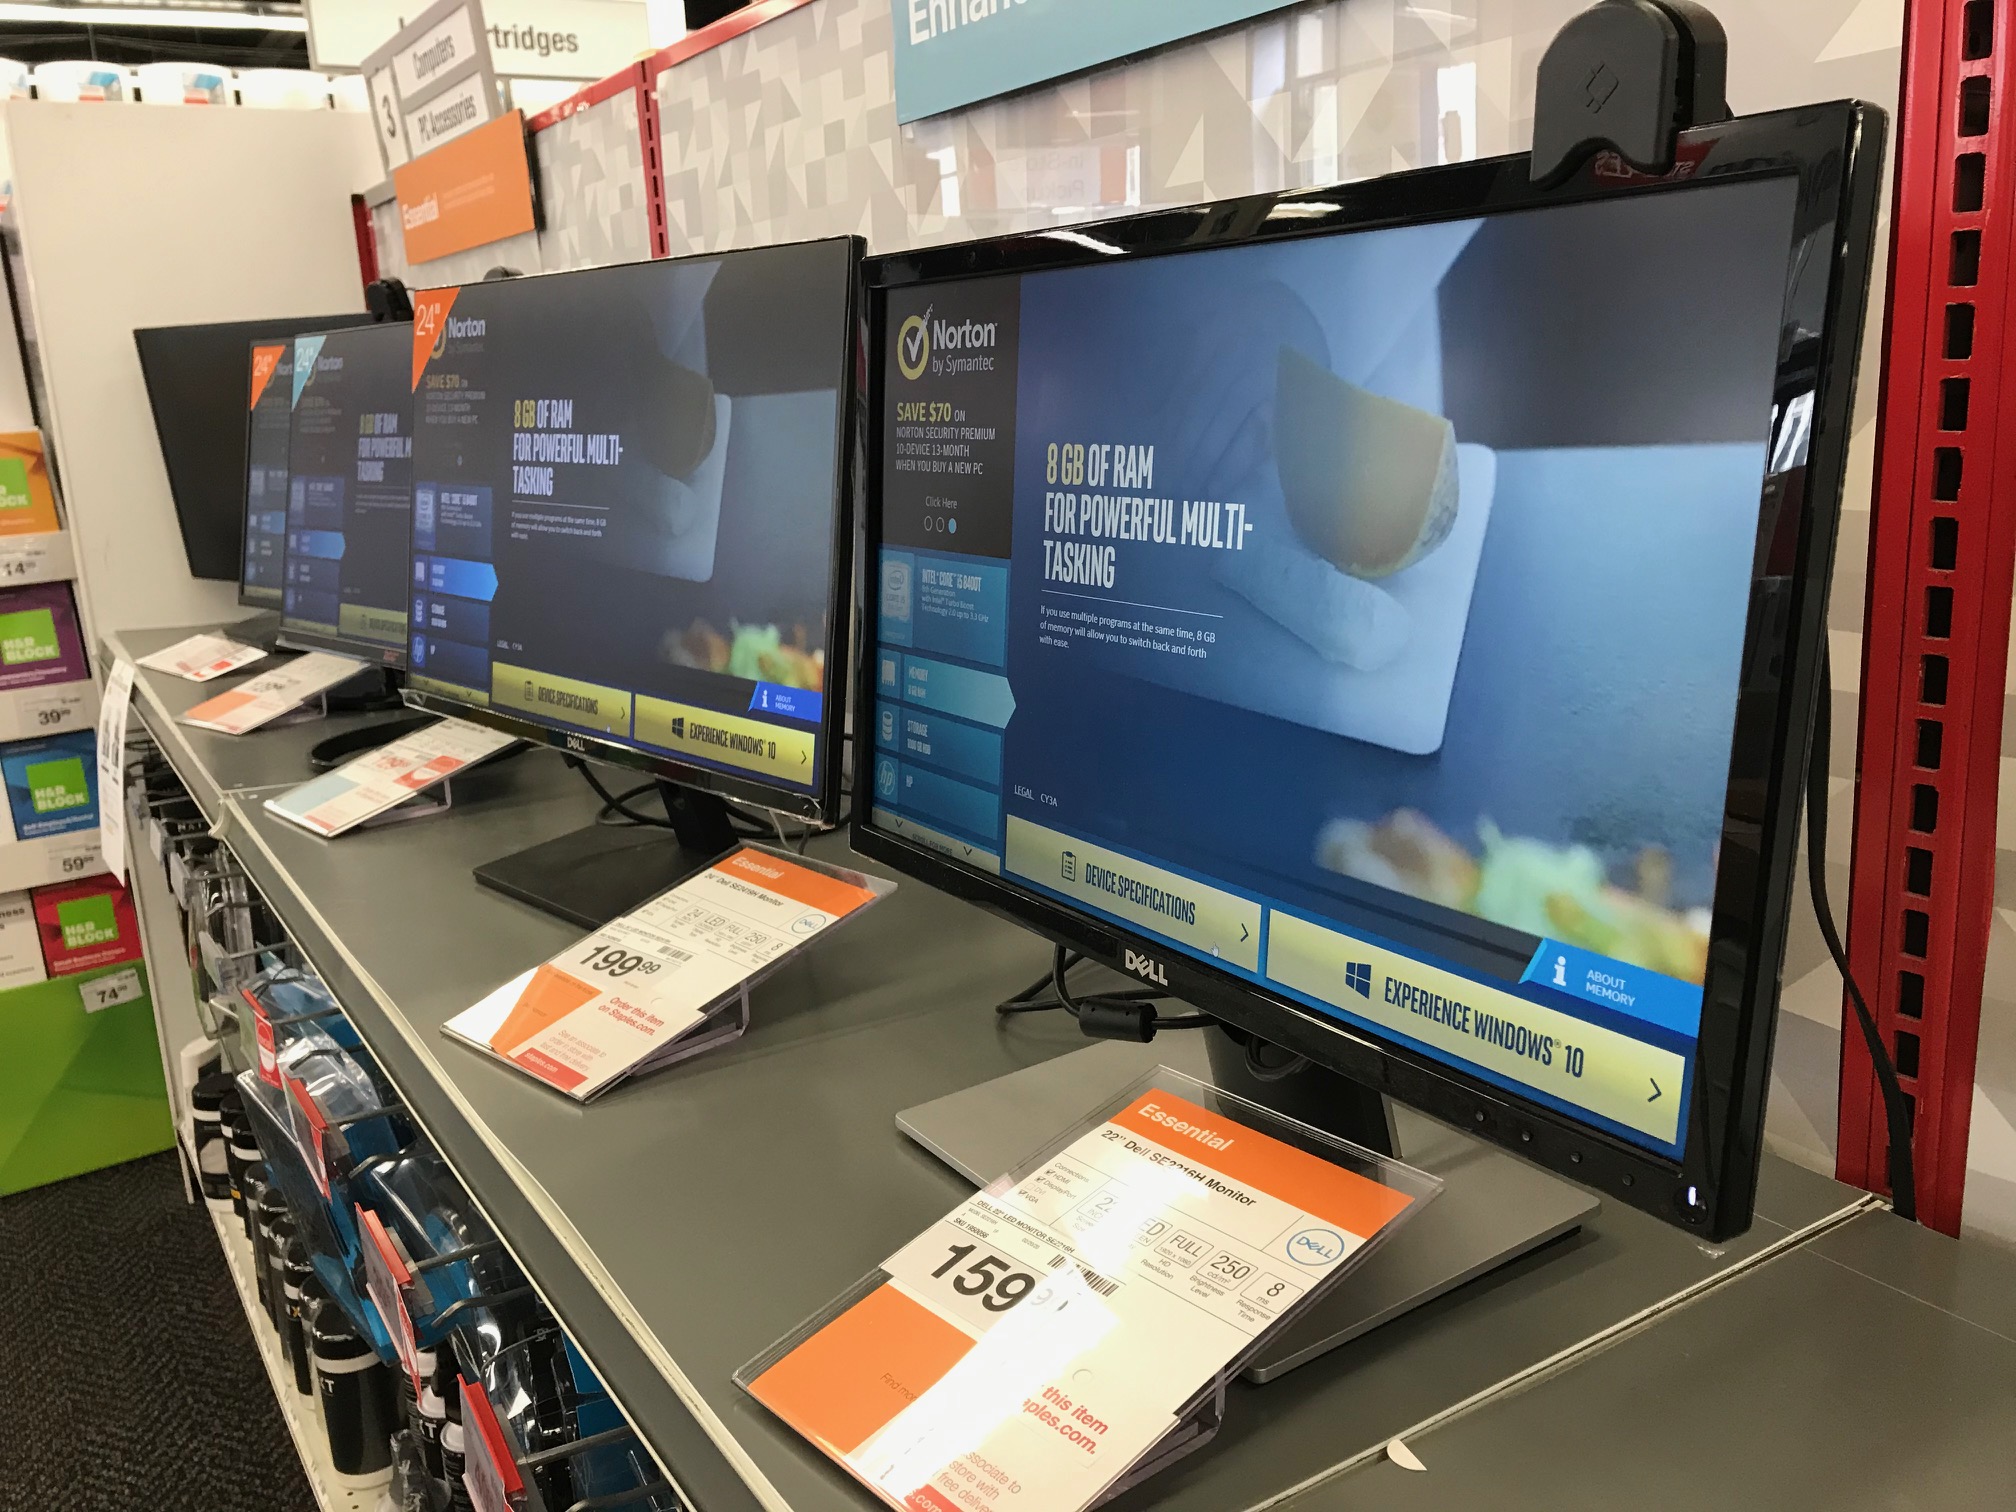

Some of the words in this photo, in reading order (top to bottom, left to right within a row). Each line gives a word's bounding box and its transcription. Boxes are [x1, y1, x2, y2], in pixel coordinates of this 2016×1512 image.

[412, 34, 456, 80] Computers
[382, 95, 397, 138] 3
[431, 92, 477, 137] Accessories
[448, 317, 485, 338] Norton
[933, 319, 997, 350] Norton
[933, 356, 943, 376] by
[946, 354, 994, 377] Symantec
[514, 400, 520, 428] 8
[522, 400, 535, 428] GB
[537, 400, 549, 428] OF
[551, 399, 573, 428] RAM
[897, 402, 926, 422] SAVE
[929, 401, 952, 424] $70
[954, 410, 966, 422] ON
[896, 427, 924, 439] NORTON
[925, 427, 959, 440] SECURITY
[960, 427, 996, 441] PREMIUM
[513, 433, 532, 461] FOR
[533, 433, 585, 463] POWERFUL
[587, 434, 623, 465] MULTI-
[896, 443, 930, 456] 10-DEVICE
[931, 444, 970, 457] 13-MONTH
[896, 459, 916, 471] WHEN
[917, 460, 931, 472] YOU
[932, 461, 947, 473] BUY
[948, 462, 954, 473] A
[955, 462, 971, 474] NEW
[973, 463, 983, 475] PC
[1047, 443, 1058, 484] 8
[1061, 443, 1085, 486] GB
[1088, 444, 1111, 487] OF
[1113, 444, 1154, 490] RAM
[512, 466, 554, 496] TASKING
[925, 496, 941, 508] Click
[942, 497, 958, 509] Here
[1045, 492, 1077, 534] FOR
[1080, 494, 1177, 544] POWERFUL
[1181, 500, 1253, 550] MULTI-
[1043, 540, 1116, 589] TASKING
[1046, 607, 1058, 619] you
[1059, 609, 1071, 619] use
[1071, 611, 1098, 625] multiple
[1099, 616, 1132, 630] programs
[1133, 621, 1141, 631] at
[1142, 622, 1154, 632] the
[1155, 626, 1175, 636] same
[1176, 627, 1195, 642] time,
[1204, 631, 1216, 643] GB
[1039, 634, 1053, 646] with
[1053, 637, 1070, 649] ease.
[1040, 620, 1048, 630] of
[1048, 622, 1074, 637] memory
[1075, 627, 1086, 638] will
[1087, 629, 1104, 641] allow
[1106, 633, 1118, 644] you
[1120, 634, 1128, 645] to
[1129, 636, 1151, 649] switch
[1152, 641, 1170, 653] back
[1171, 643, 1186, 655] and
[1187, 645, 1207, 659] forth
[538, 685, 556, 703] DEVICE
[556, 689, 598, 715] SPECIFICATIONS
[775, 694, 792, 703] ABOUT
[775, 701, 796, 712] MEMORY
[907, 719, 928, 737] STORAGE
[567, 736, 585, 751] DELL
[690, 722, 728, 748] EXPERIENCE
[767, 741, 777, 760] 10
[37, 792, 85, 811] BLOCK
[1014, 784, 1034, 799] LEGAL
[731, 857, 784, 880] Essential
[757, 892, 785, 907] Monitor
[1086, 862, 1117, 895] DEVICE
[1117, 874, 1196, 926] SPECIFICATIONS
[67, 928, 115, 948] BLOCK
[1125, 949, 1168, 987] DELL
[1587, 969, 1626, 992] ABOUT
[1586, 982, 1636, 1007] MEMORY
[598, 1004, 611, 1013] on
[609, 996, 632, 1012] Order
[631, 1006, 647, 1019] this
[645, 1014, 665, 1028] item
[1384, 976, 1470, 1036] EXPERIENCE
[1564, 1044, 1584, 1079] 10
[524, 1051, 558, 1074] staples.com
[1138, 1103, 1235, 1151] Essential
[1053, 1173, 1071, 1185] HDMI
[1055, 1162, 1090, 1183] Connections
[1123, 1139, 1150, 1158] Dell
[1205, 1178, 1258, 1207] Monitor
[1025, 1194, 1039, 1204] VGA
[1043, 1179, 1077, 1199] DisplayPort
[953, 1217, 967, 1228] SKU
[977, 1200, 993, 1212] DELL
[1003, 1213, 1018, 1224] LED
[1016, 1220, 1047, 1239] MONITOR
[1169, 1234, 1204, 1258] FULL
[1294, 1235, 1335, 1260] DELL
[1141, 1258, 1175, 1280] Resolution
[1158, 1257, 1171, 1268] HD
[1210, 1254, 1251, 1282] 250
[931, 1244, 1036, 1312] 159
[1189, 1274, 1226, 1298] Brightness
[1189, 1285, 1210, 1299] Level
[1266, 1282, 1286, 1298] 8
[1235, 1298, 1272, 1322] Response
[1237, 1309, 1256, 1324] Time
[1042, 1385, 1073, 1411] this
[1071, 1405, 1109, 1435] item
[937, 1472, 960, 1492] free
[949, 1460, 977, 1484] store
[976, 1478, 1001, 1501] with
[1008, 1480, 1022, 1495] to
